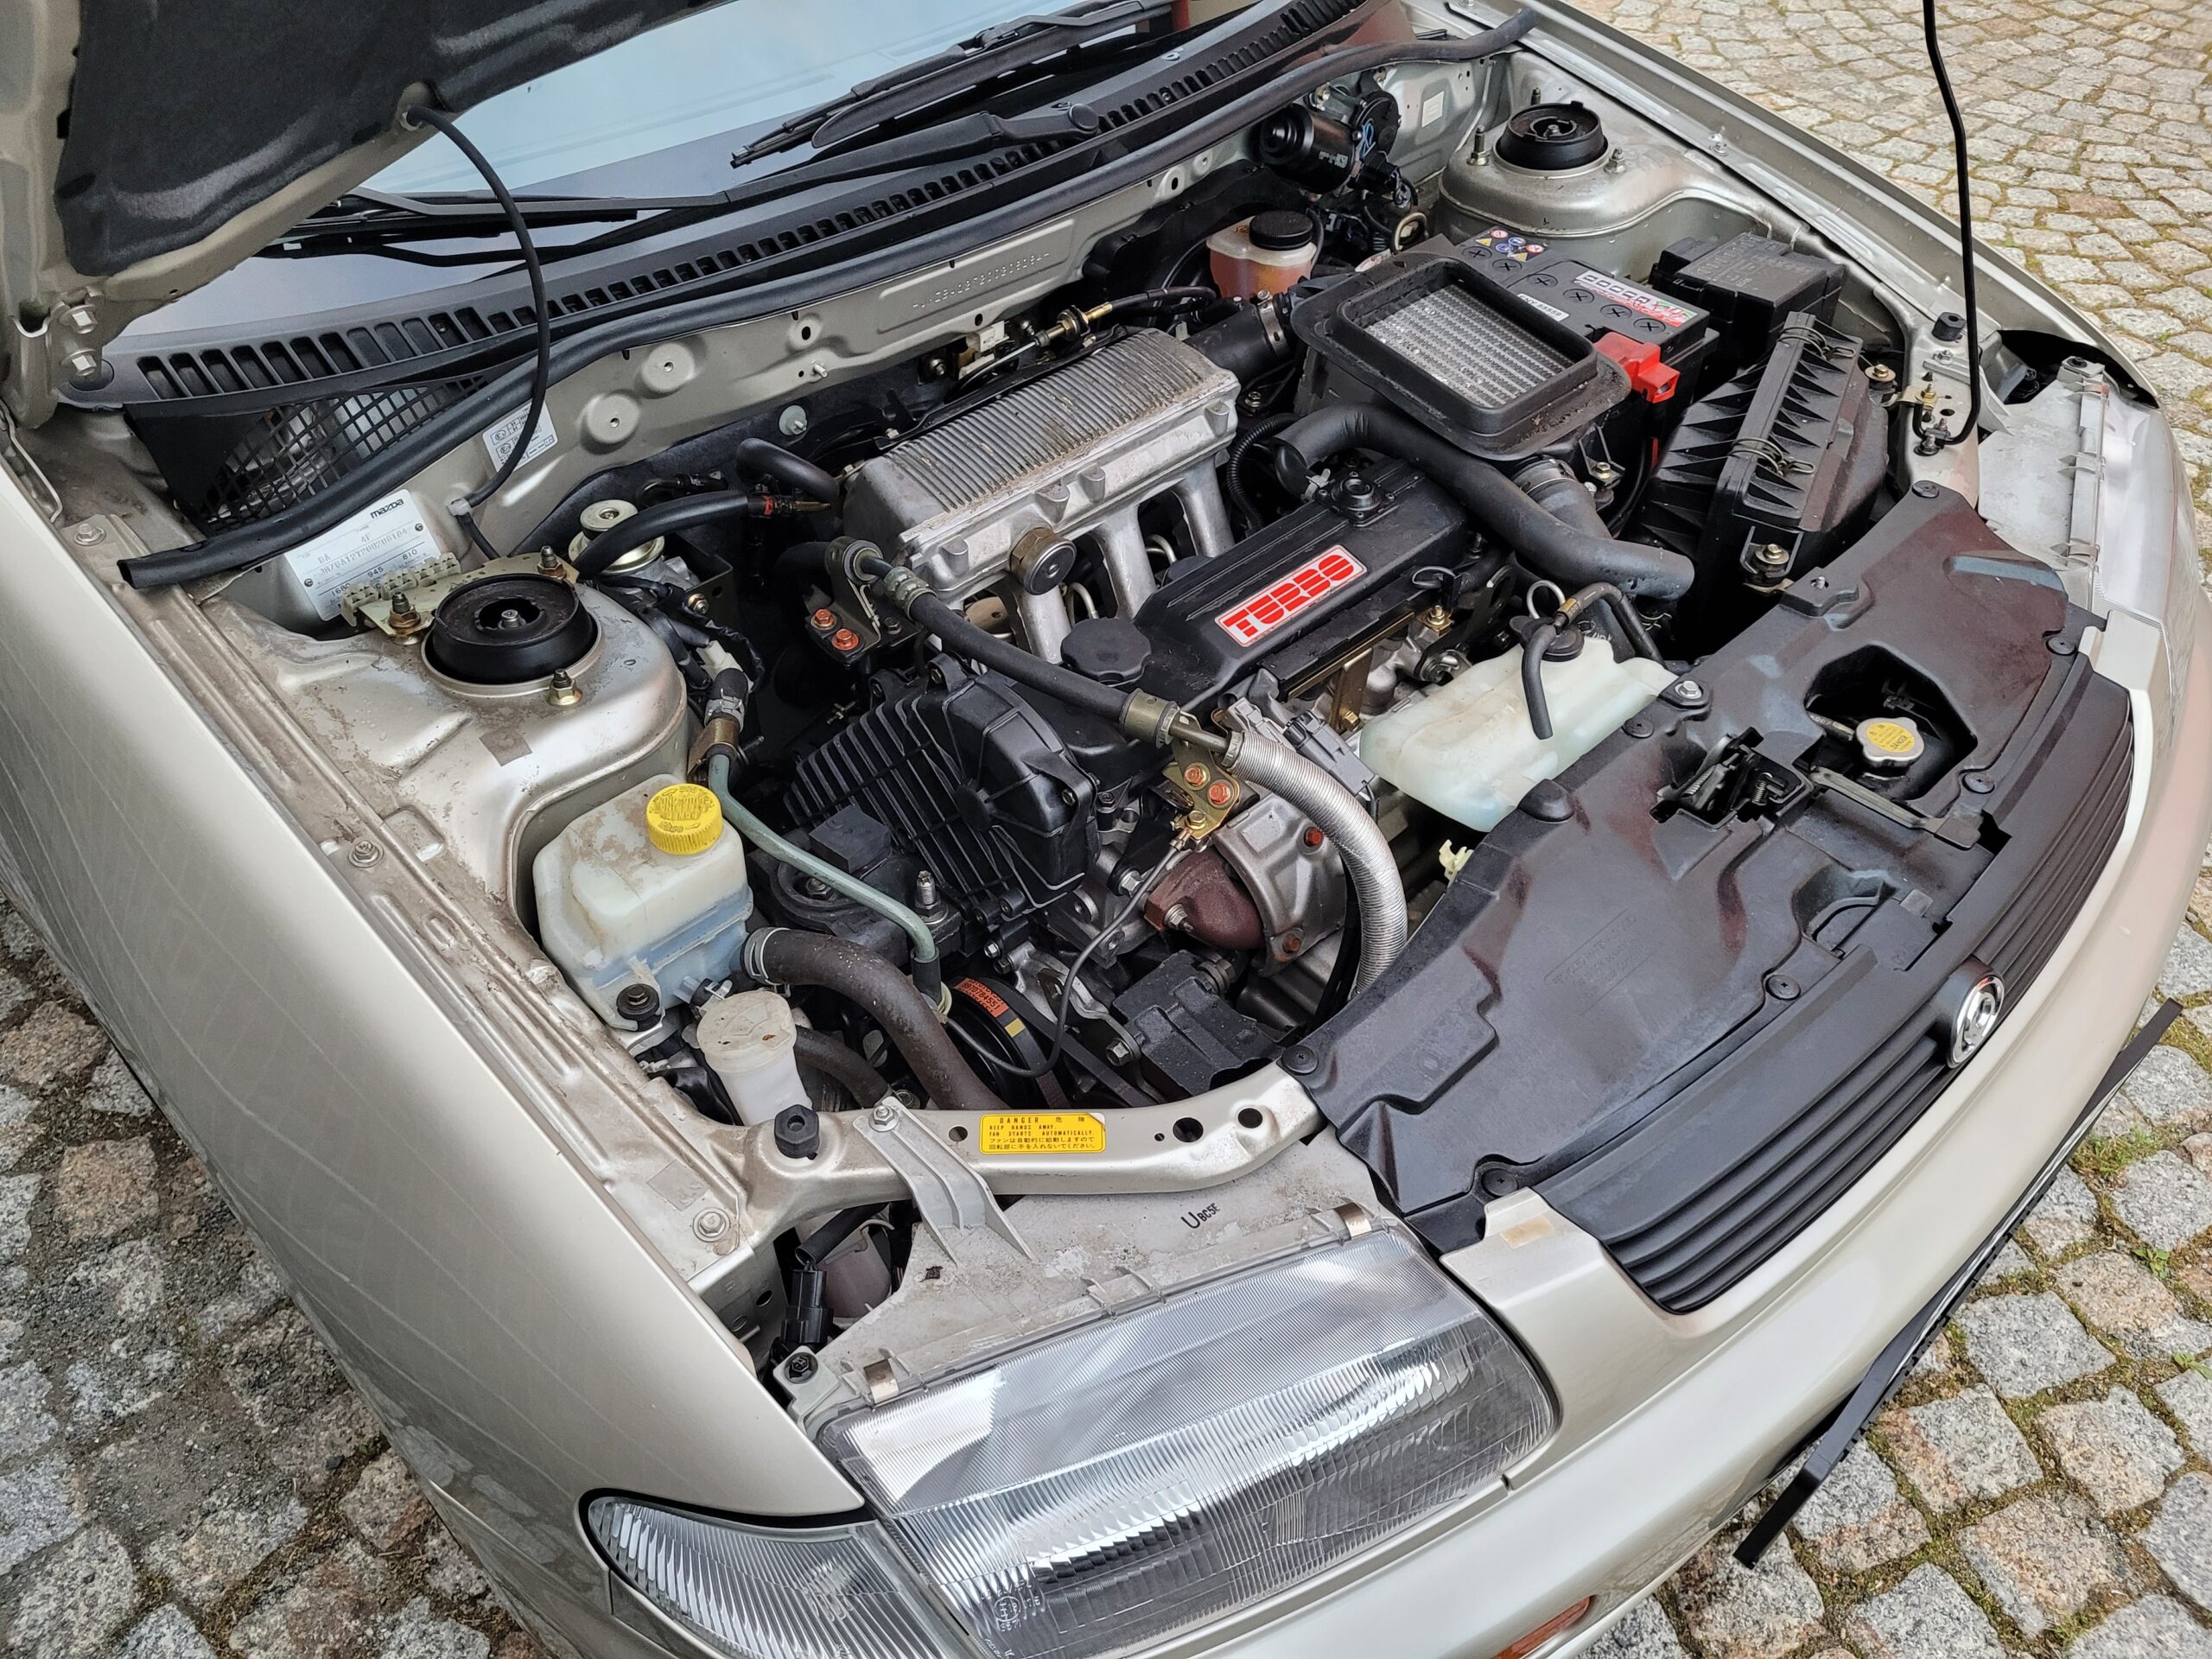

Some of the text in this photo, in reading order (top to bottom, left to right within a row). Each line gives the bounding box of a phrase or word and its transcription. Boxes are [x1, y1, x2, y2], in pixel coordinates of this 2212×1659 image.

[370, 499, 404, 518] mazda
[402, 549, 418, 561] 810
[367, 566, 384, 578] 945
[1223, 554, 1354, 638] TURBO
